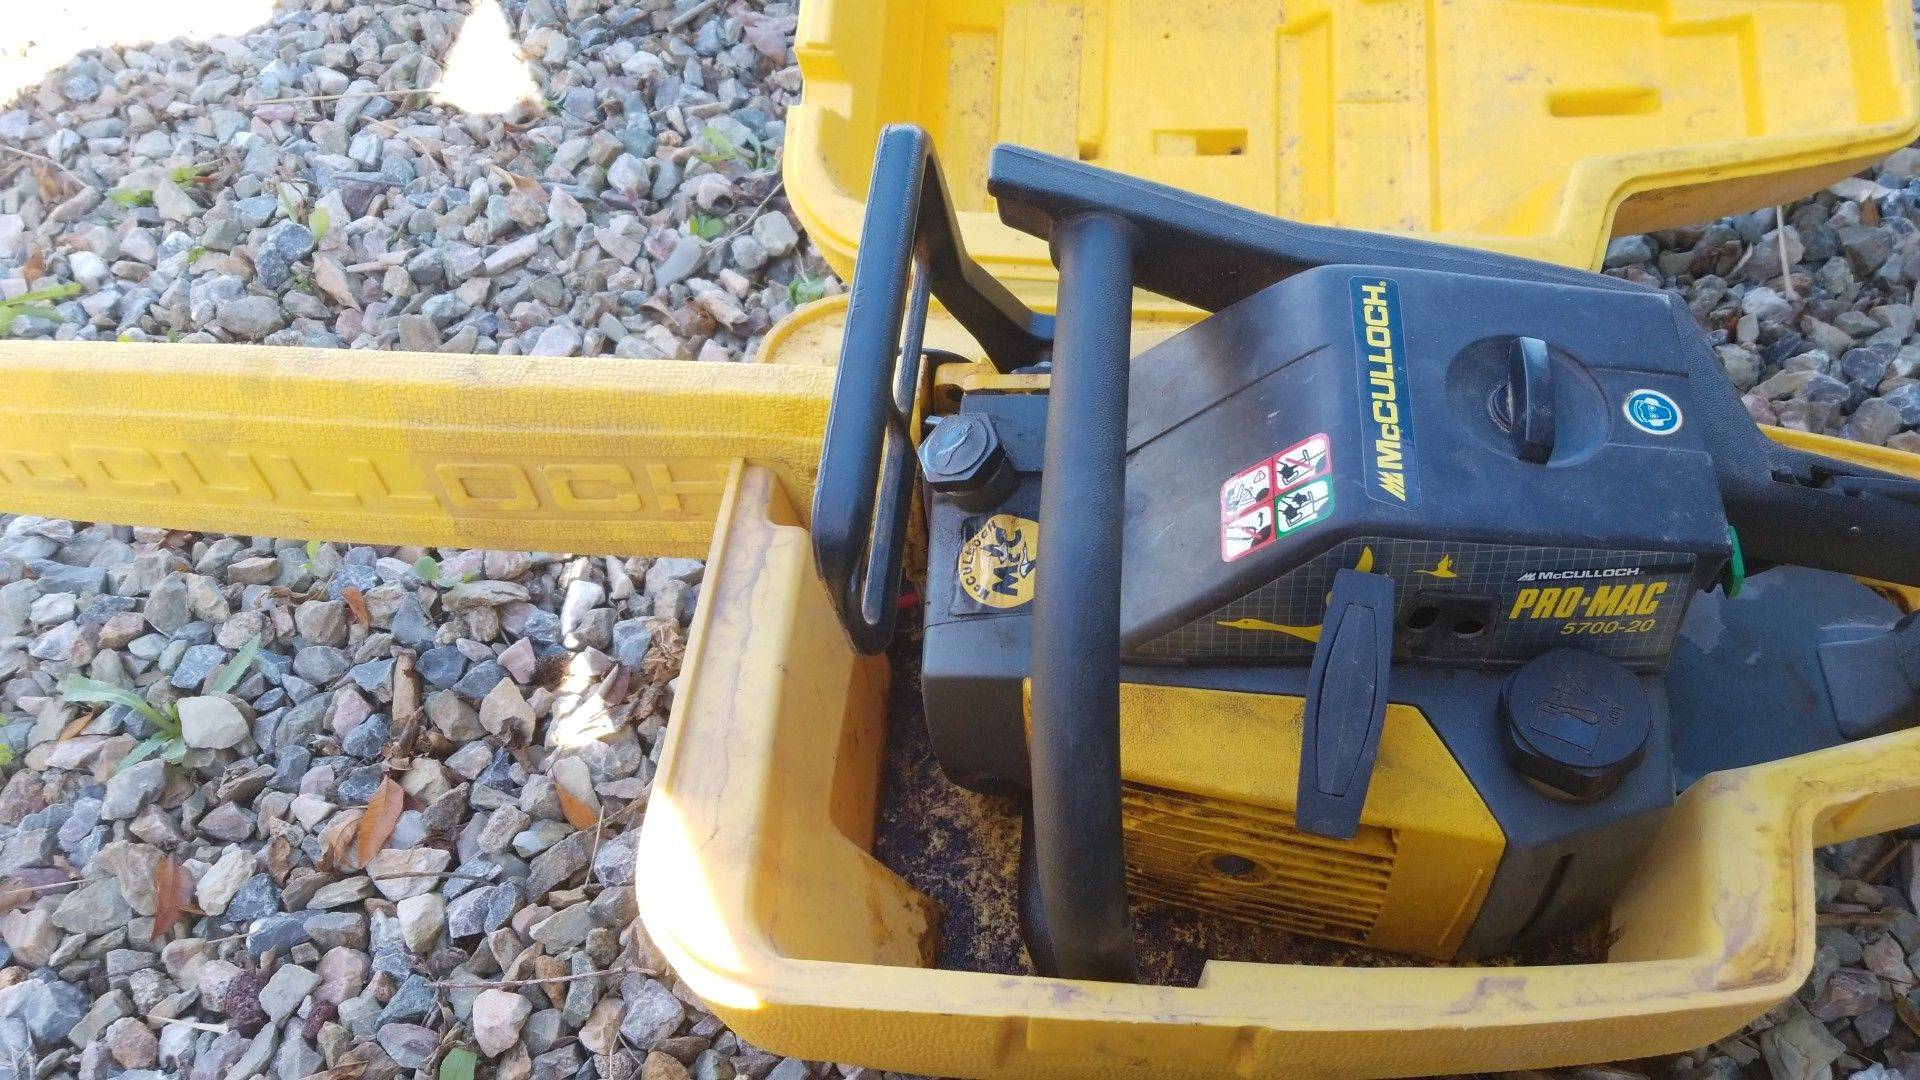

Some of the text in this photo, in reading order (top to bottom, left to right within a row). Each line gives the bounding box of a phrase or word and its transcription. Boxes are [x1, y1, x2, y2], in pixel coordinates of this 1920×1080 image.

[1361, 284, 1403, 470] McCULLOCH
[1537, 567, 1640, 580] McCULLOCH
[1508, 581, 1668, 619] PRO-MAC
[1560, 619, 1657, 635] 5700-20
